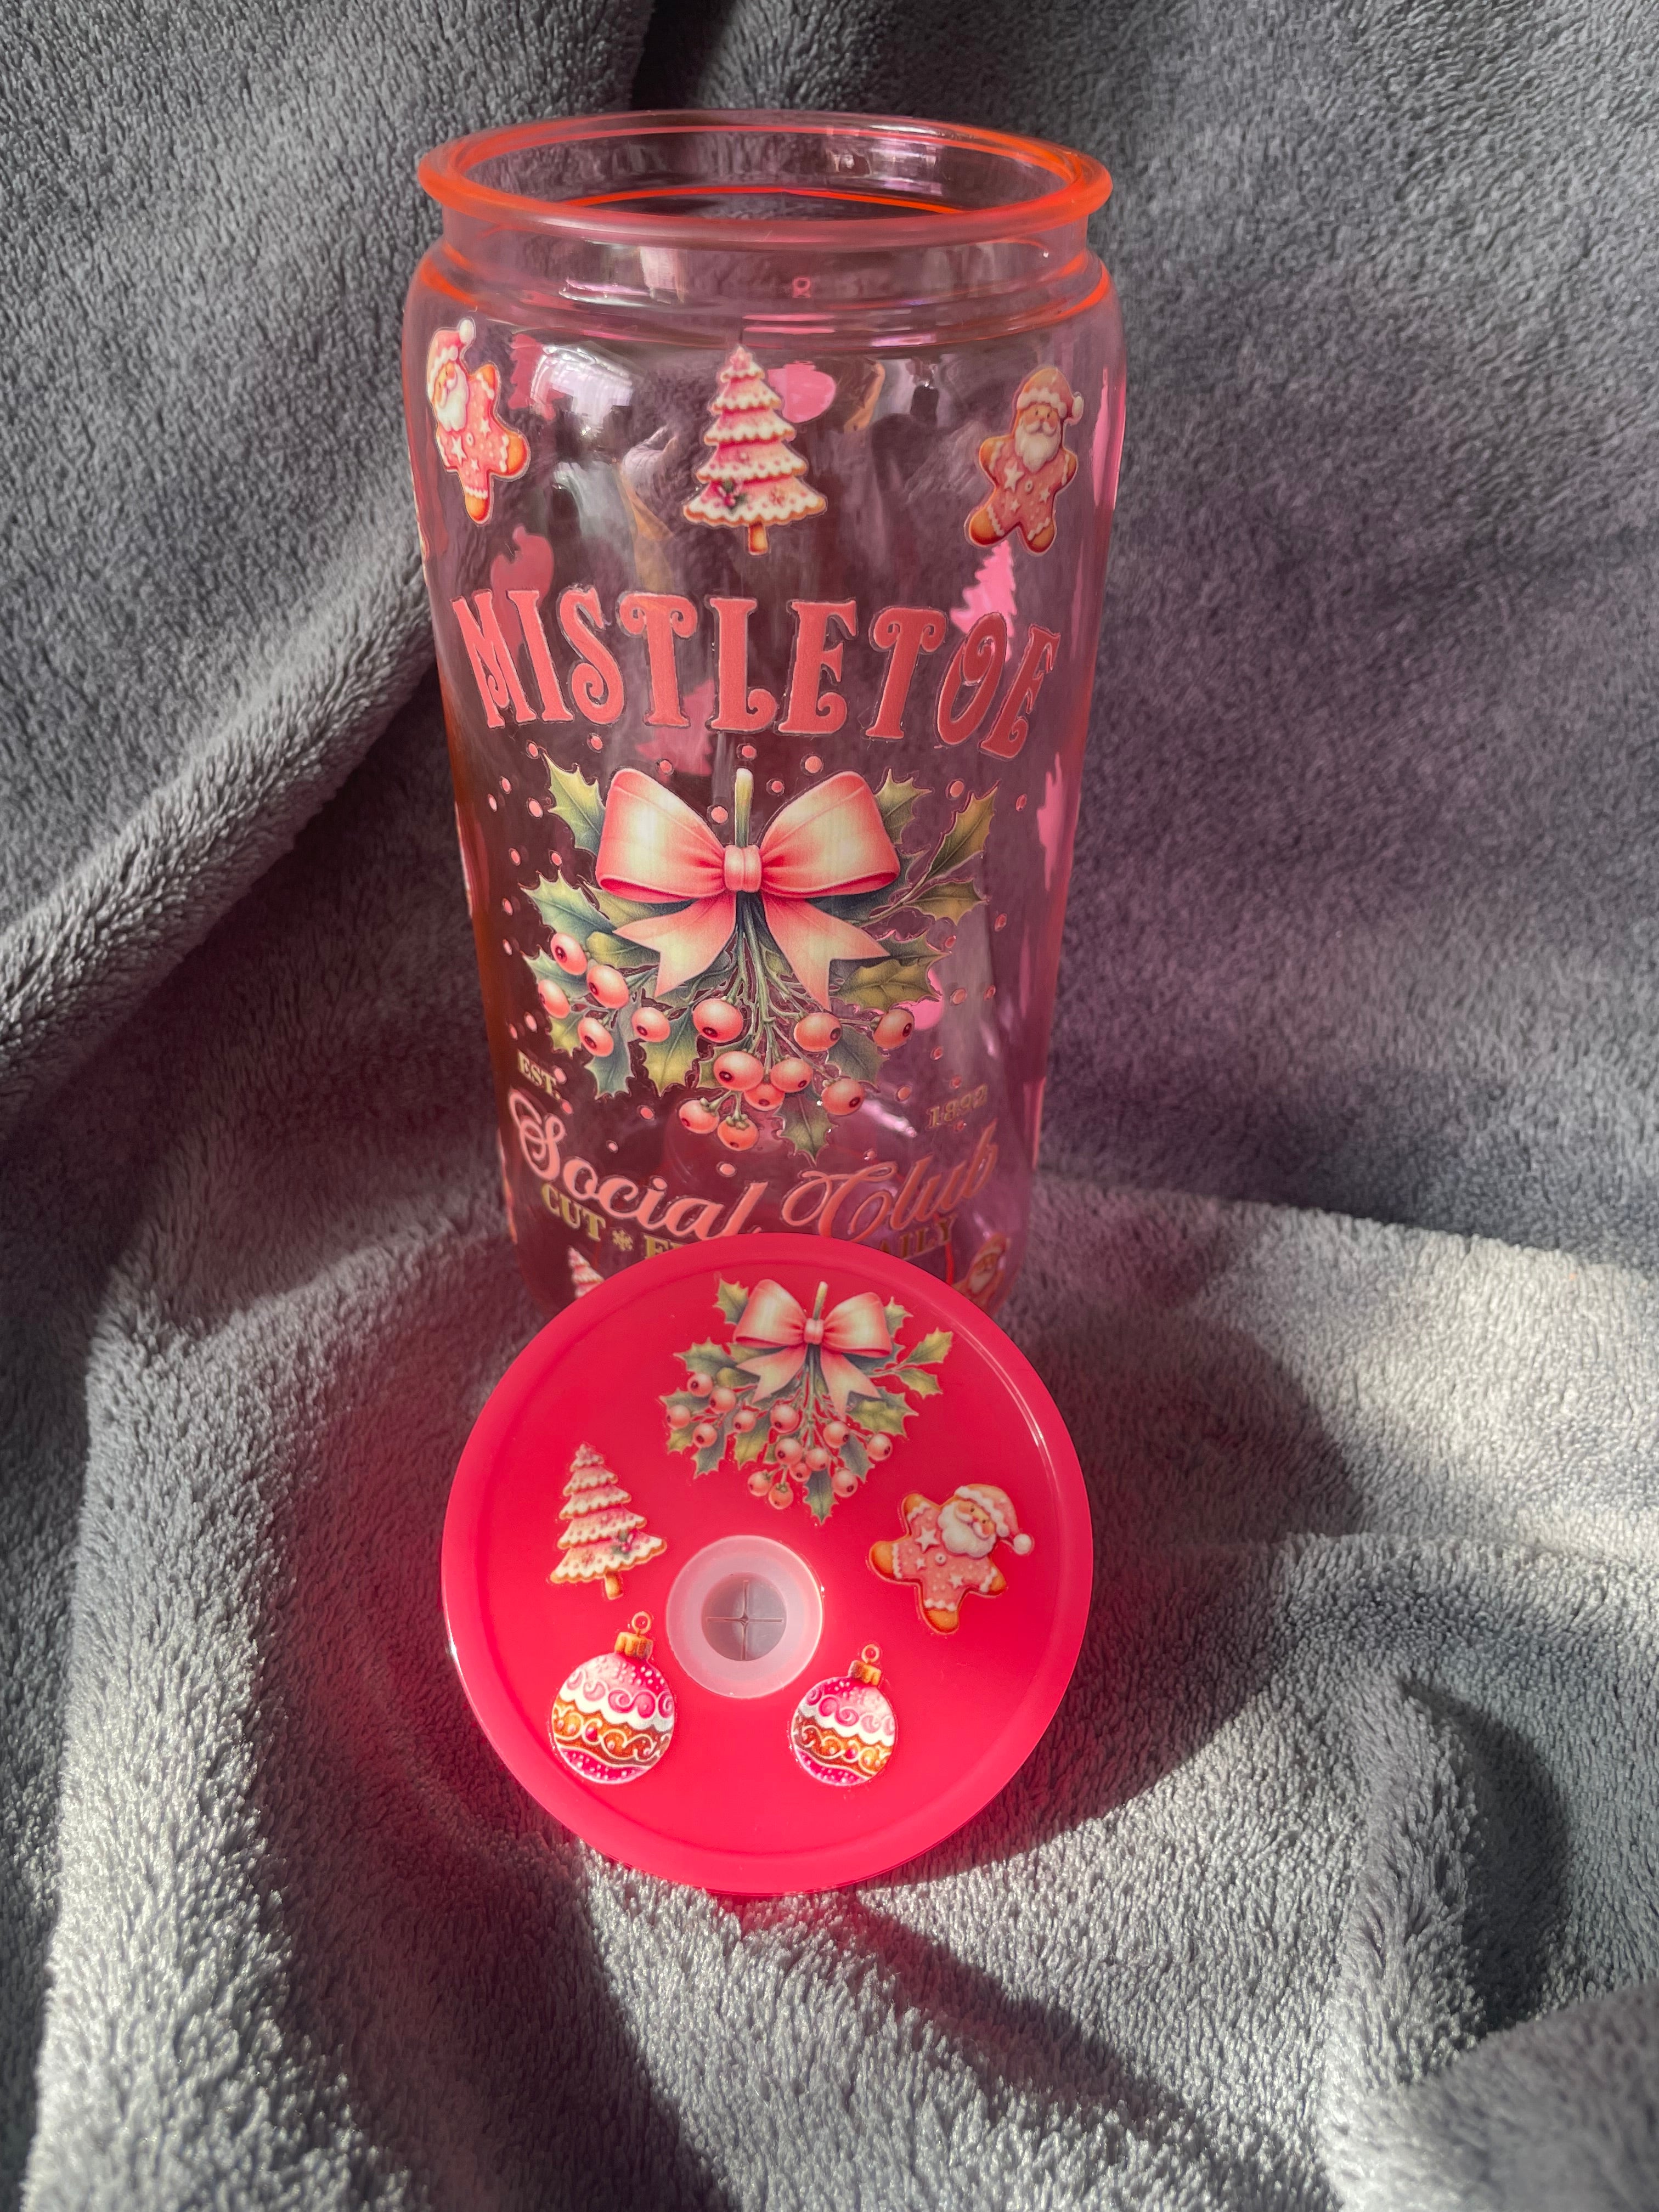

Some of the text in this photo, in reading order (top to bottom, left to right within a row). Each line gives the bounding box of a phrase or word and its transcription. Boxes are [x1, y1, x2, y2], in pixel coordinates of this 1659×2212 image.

[452, 585, 1061, 758] MISTLETOE
[517, 1049, 561, 1100] EST.
[509, 1089, 998, 1242] Social Club
[541, 1183, 606, 1241] CUT
